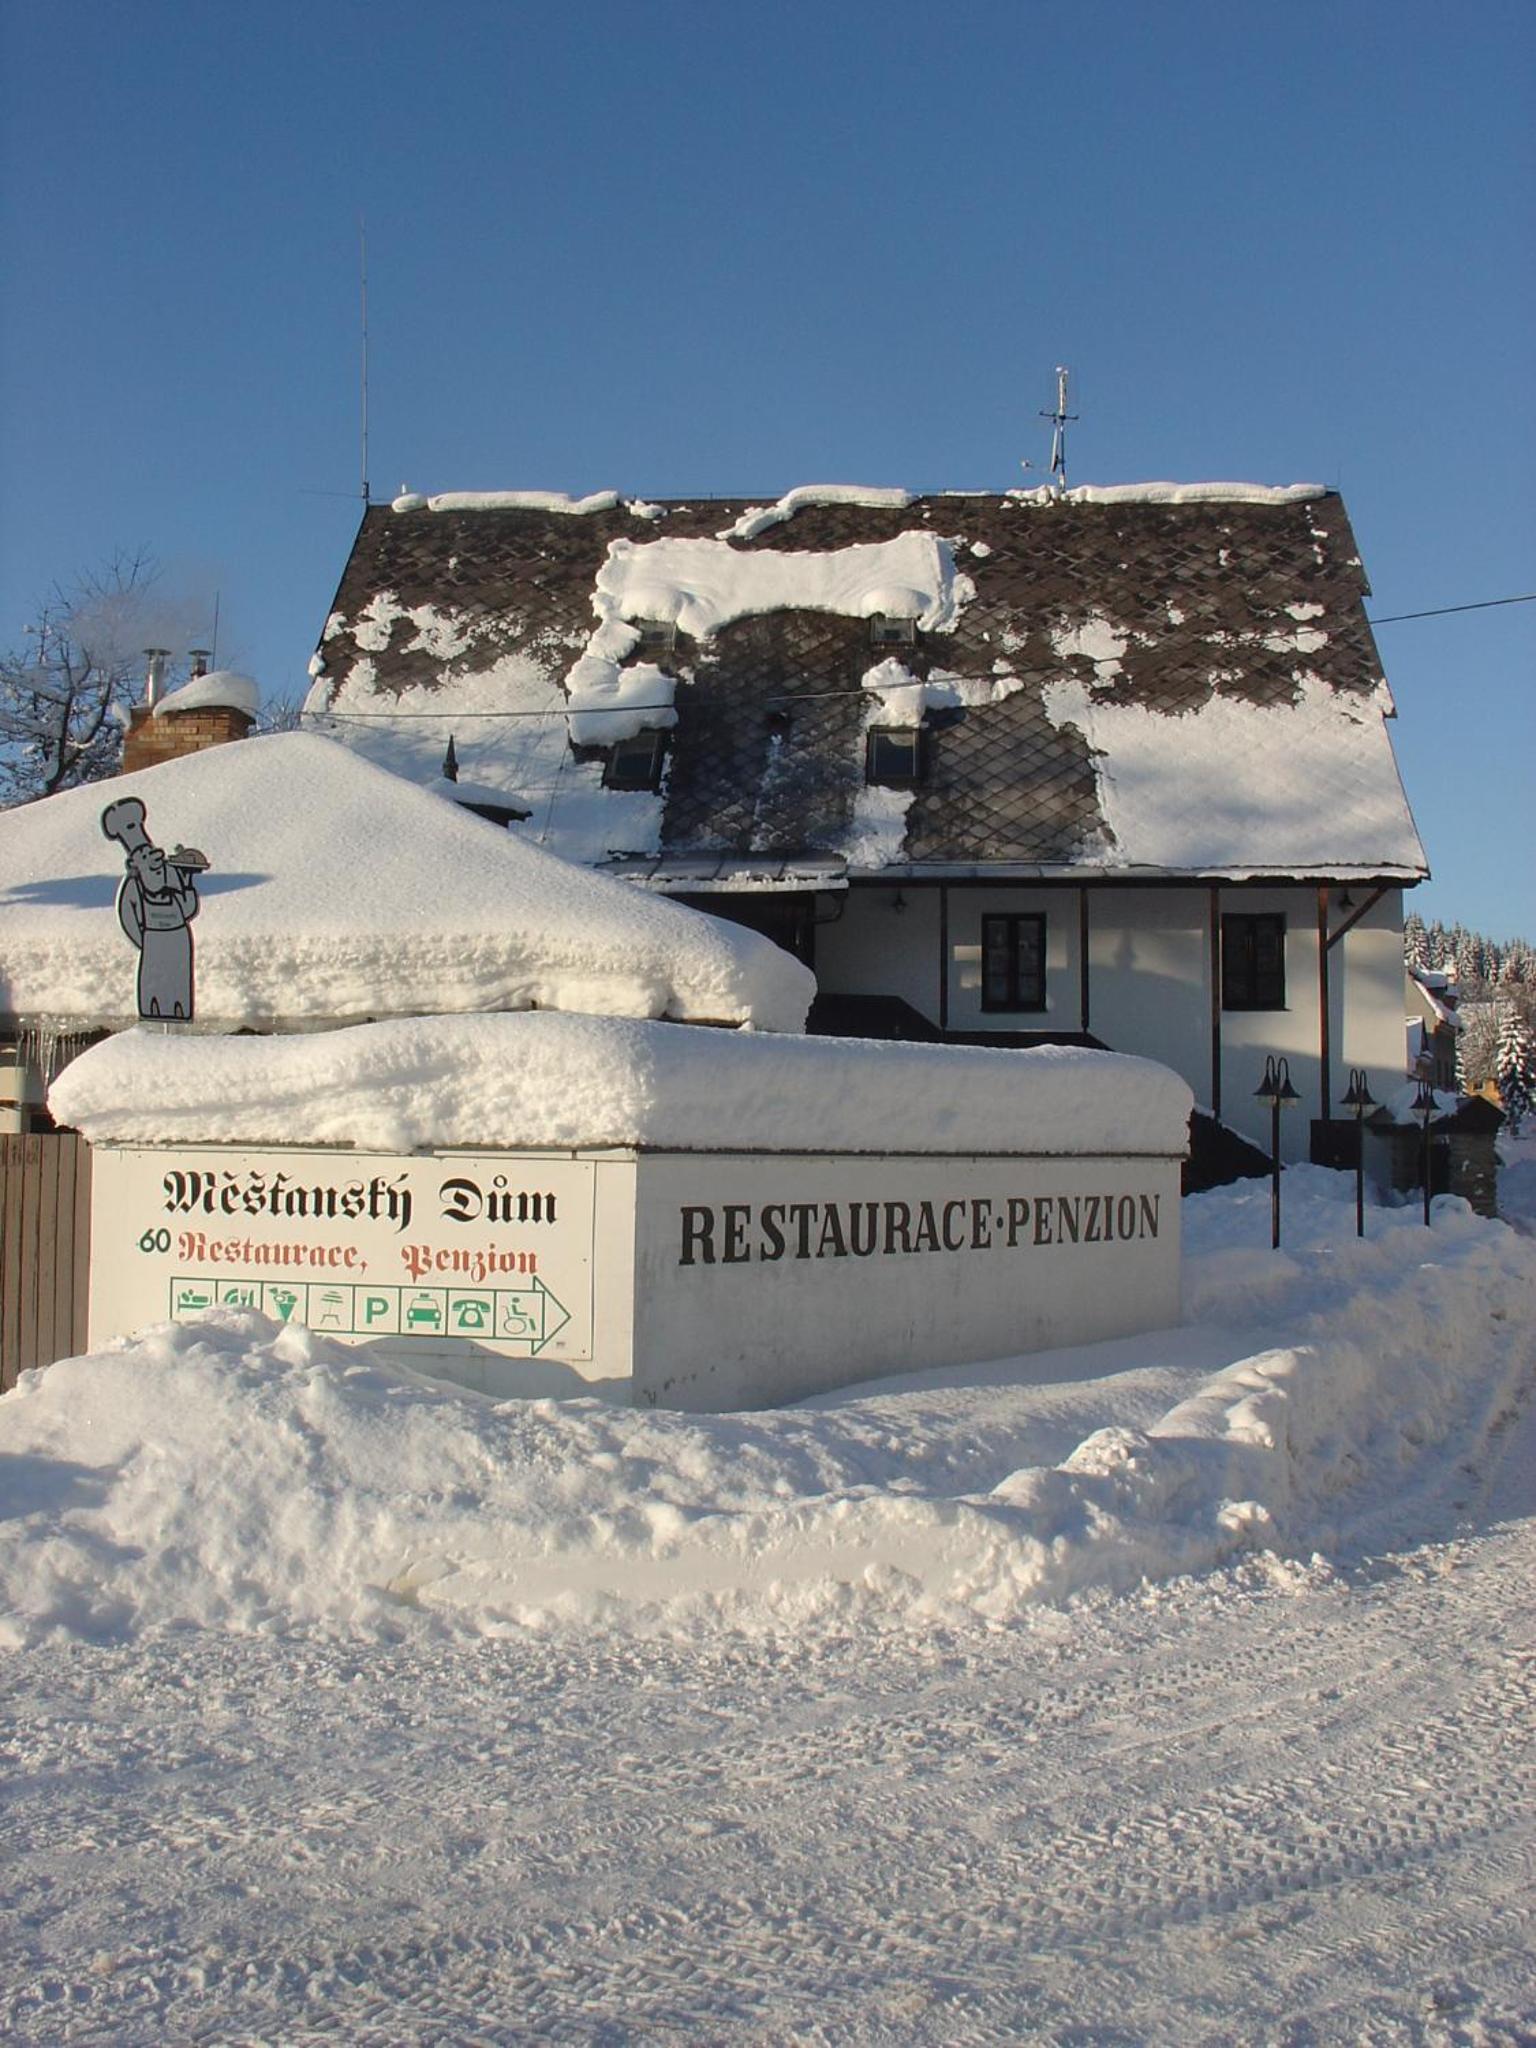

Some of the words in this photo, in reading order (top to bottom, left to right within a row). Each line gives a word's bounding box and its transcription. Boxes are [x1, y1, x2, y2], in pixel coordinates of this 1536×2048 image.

[439, 1175, 557, 1224] Dům
[139, 1228, 171, 1253] 60
[178, 1231, 368, 1275] Restaurace,
[401, 1242, 537, 1284] Penzion
[366, 1297, 389, 1324] P
